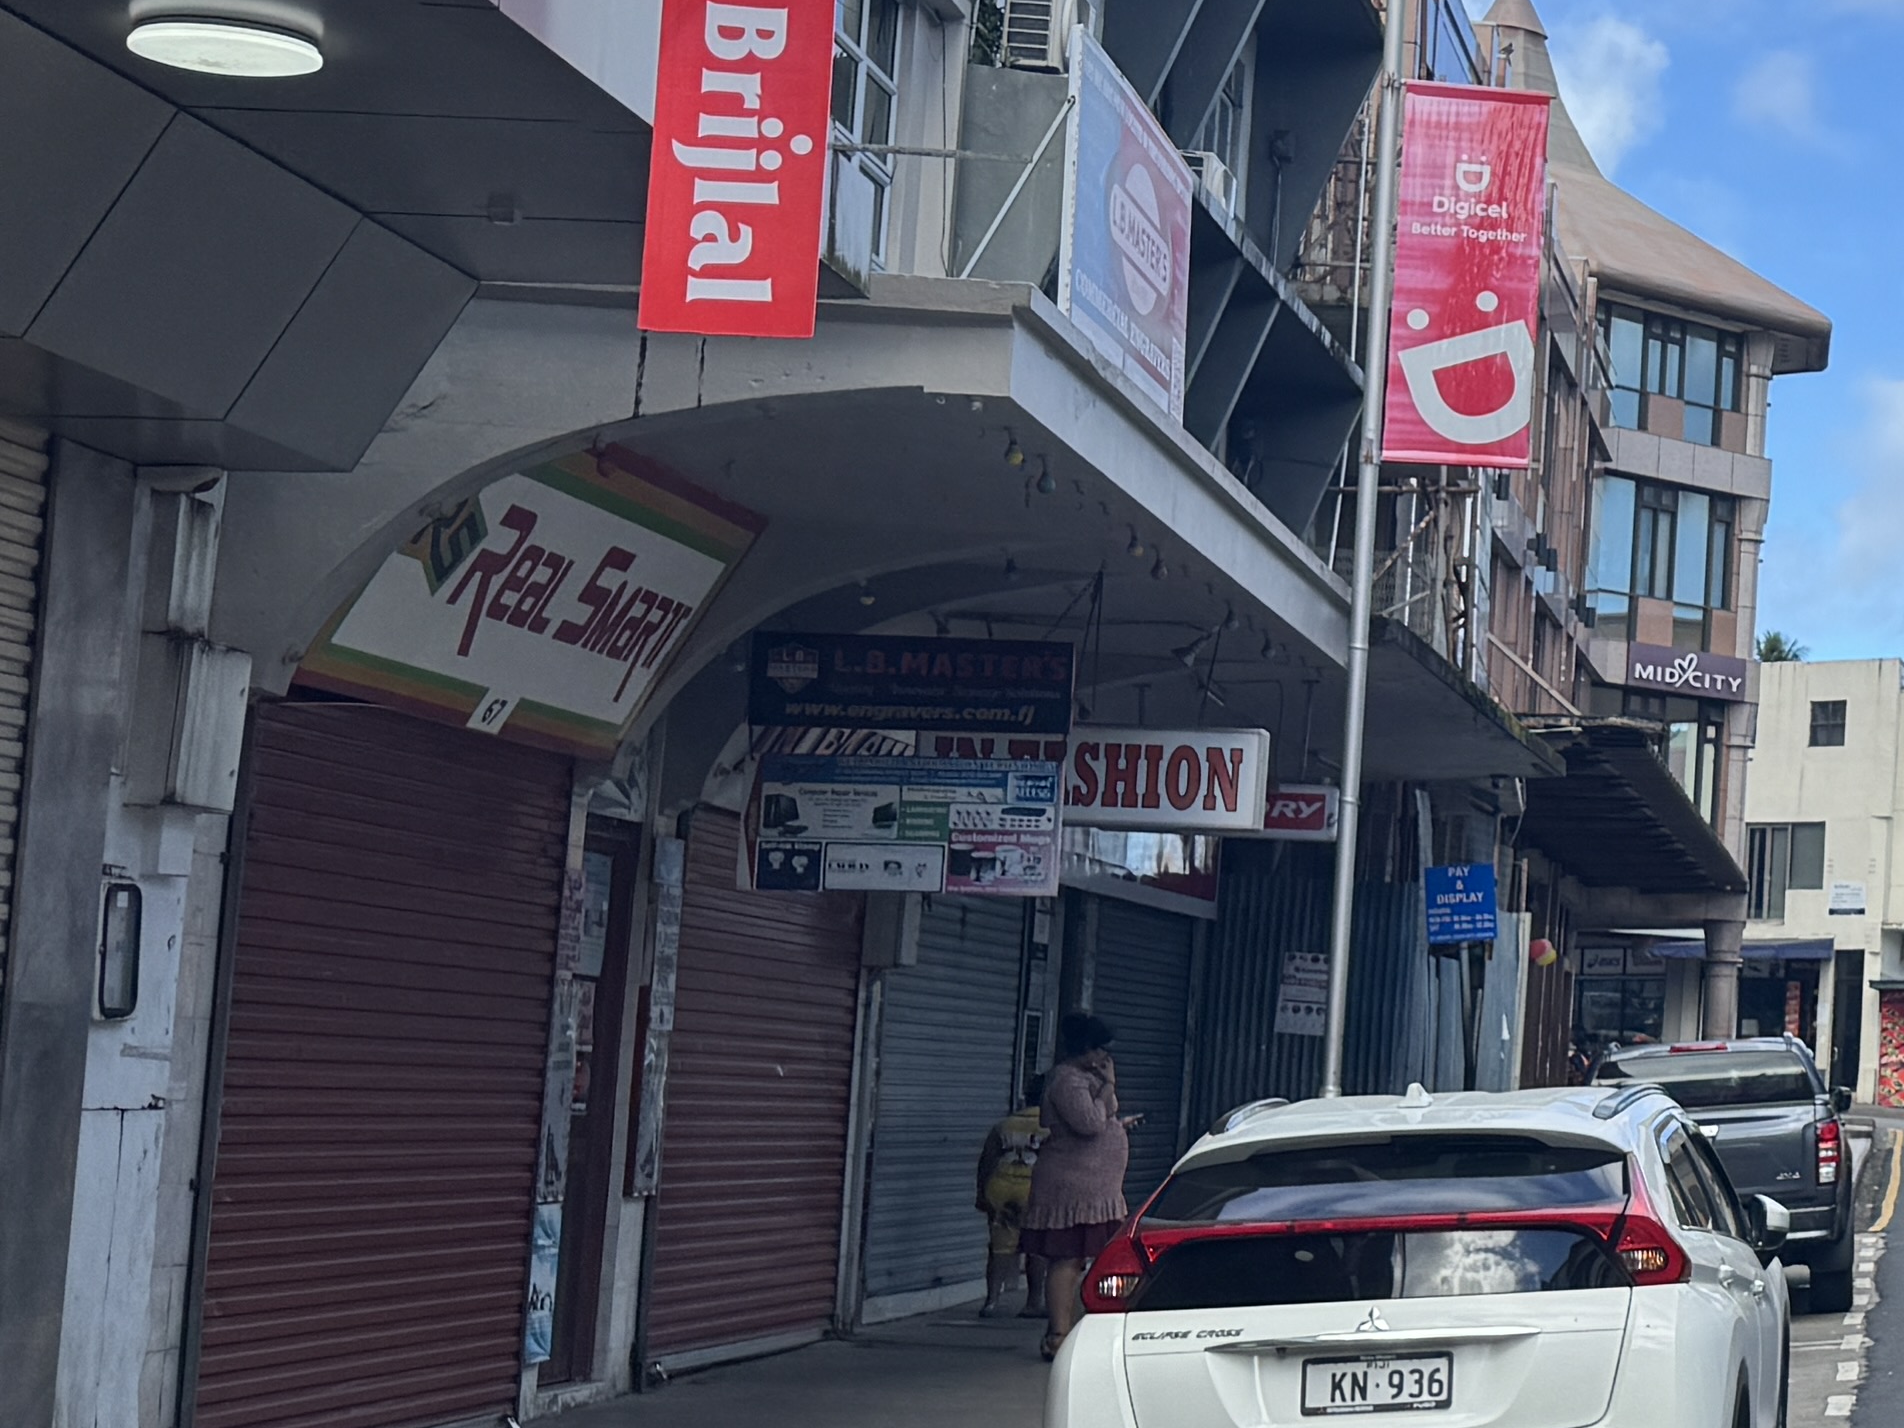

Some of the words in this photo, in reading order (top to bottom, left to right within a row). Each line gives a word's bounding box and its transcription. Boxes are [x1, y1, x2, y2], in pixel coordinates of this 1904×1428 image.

[672, 1, 813, 303] Brijal
[1432, 195, 1509, 220] Digicel
[1411, 222, 1457, 237] Better
[1461, 225, 1528, 243] Together
[481, 698, 509, 725] 67
[785, 703, 1035, 725] www.engravers.com.fj
[1265, 799, 1325, 819] RY
[951, 832, 1018, 843] Customized
[1448, 865, 1471, 877] PAY
[1456, 879, 1464, 891] &
[1437, 892, 1484, 905] DISPLAY
[1330, 1371, 1369, 1403] KN
[1388, 1367, 1444, 1400] 936
